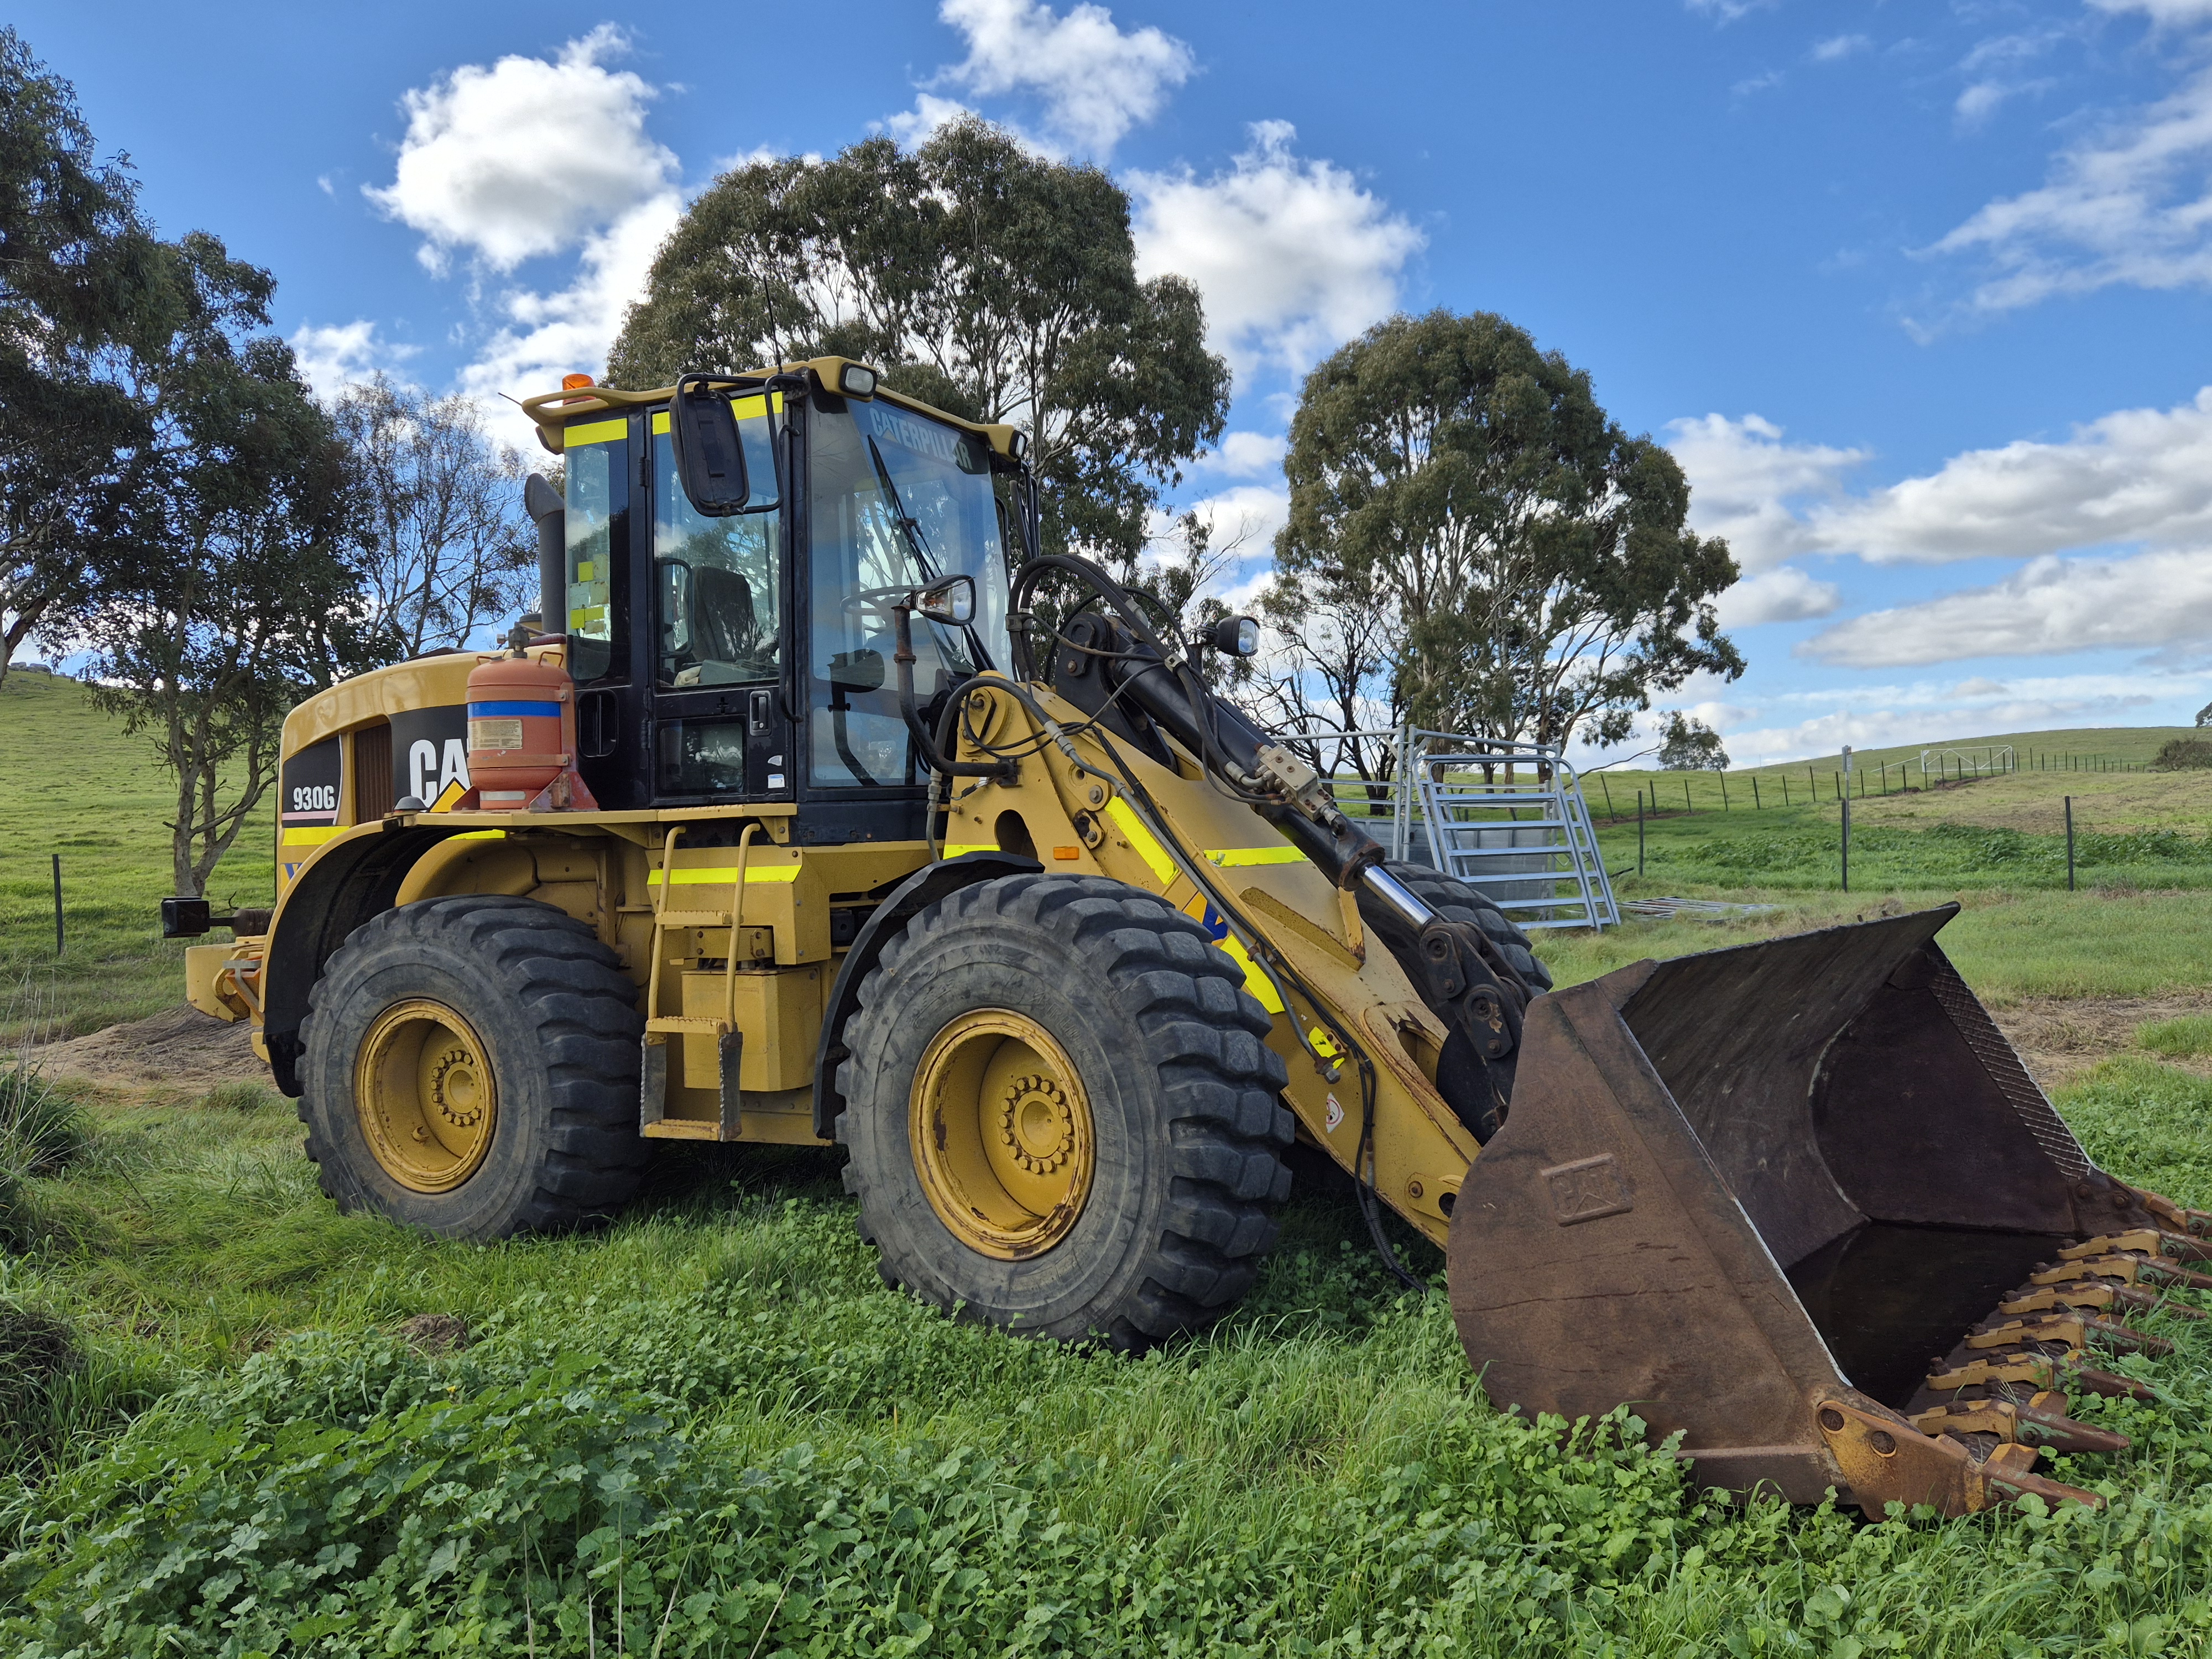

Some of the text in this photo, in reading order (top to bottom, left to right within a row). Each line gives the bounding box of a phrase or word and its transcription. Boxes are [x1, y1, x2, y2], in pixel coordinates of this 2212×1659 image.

[869, 408, 973, 470] CATERPILLAR
[293, 785, 335, 811] 930G
[409, 738, 471, 809] CA
[1030, 986, 1119, 1159] BRIDSTONE
